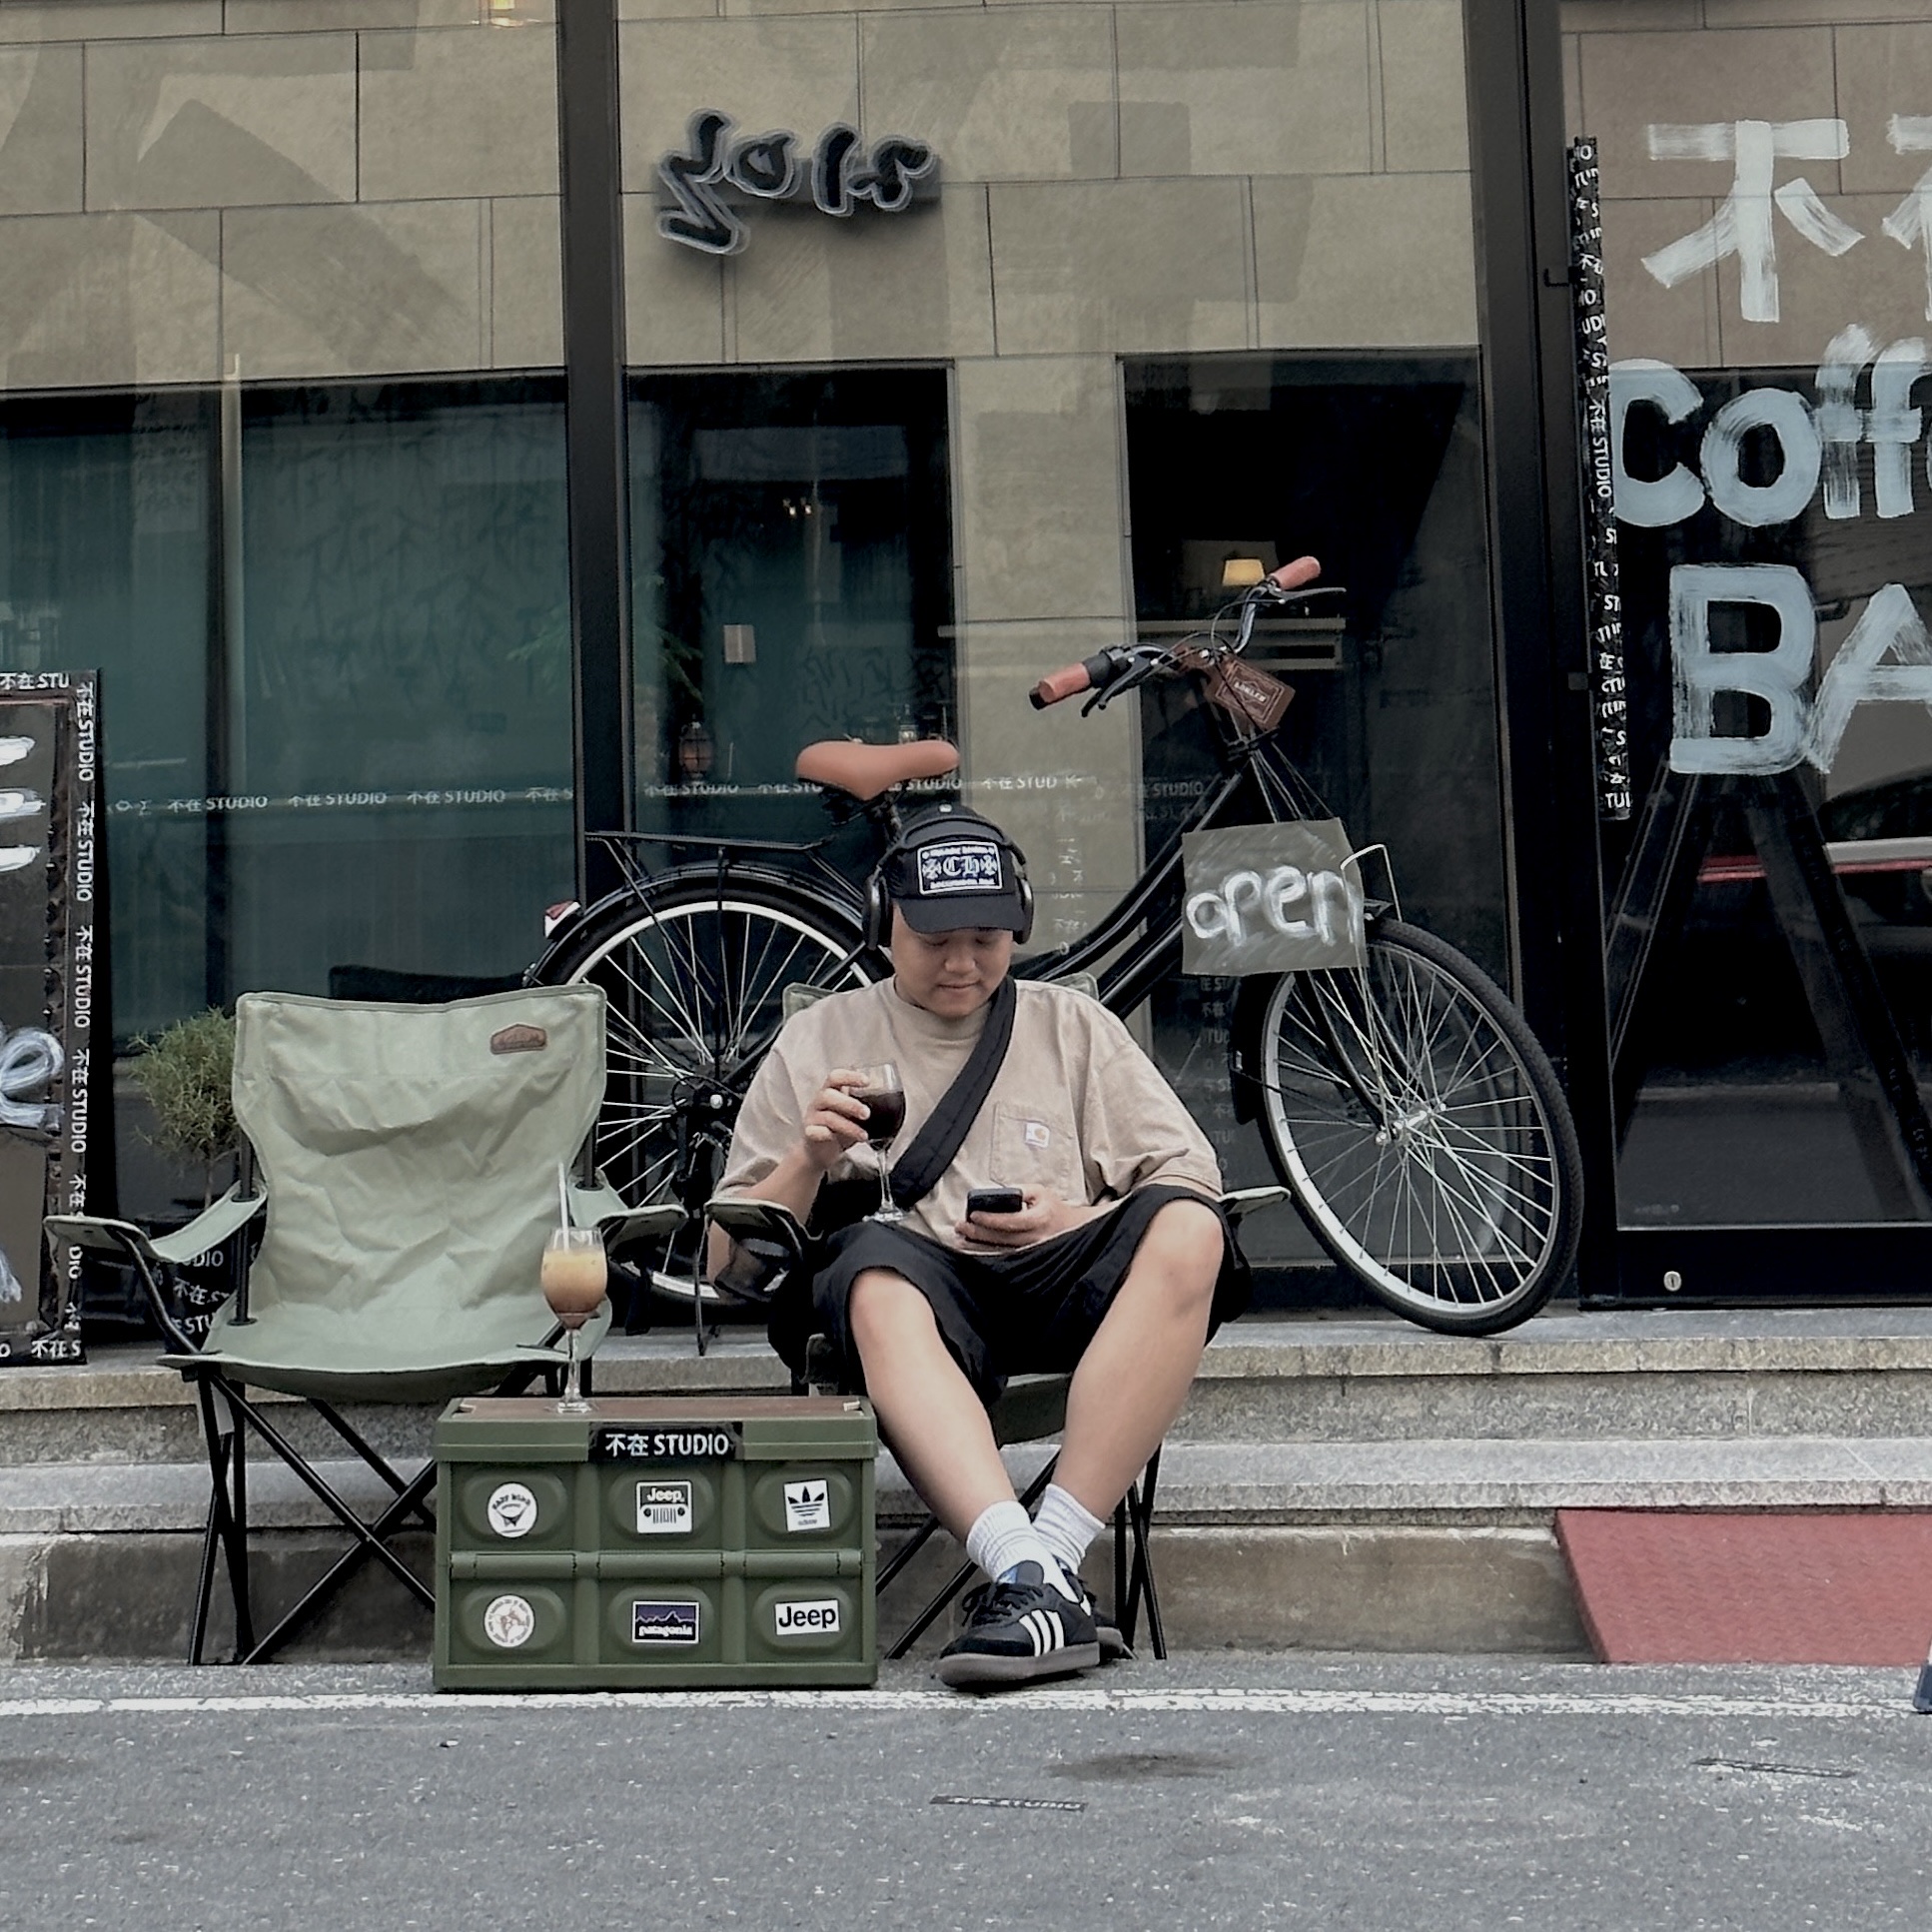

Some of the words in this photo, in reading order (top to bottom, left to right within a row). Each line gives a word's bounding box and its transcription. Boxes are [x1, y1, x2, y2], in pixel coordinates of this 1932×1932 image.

[1592, 437, 1612, 498] STUDIO
[77, 682, 94, 717] 不在
[78, 719, 95, 781] STUDIO
[325, 792, 388, 806] STUDIO
[444, 789, 506, 803] STUDIO
[905, 777, 962, 791] STUDIO
[206, 796, 269, 810] STUDIO
[76, 838, 94, 902] STUDIO
[74, 925, 94, 961] 不在
[74, 964, 92, 1028] STUDIO
[72, 1048, 90, 1085] 不在
[71, 1088, 88, 1153] STUDIO
[69, 1174, 87, 1209] 不在
[31, 1340, 68, 1359] 不在
[605, 1433, 649, 1457] 不在
[653, 1433, 729, 1456] STUDIO
[646, 1487, 683, 1503] Jeep
[779, 1605, 836, 1629] Jeep
